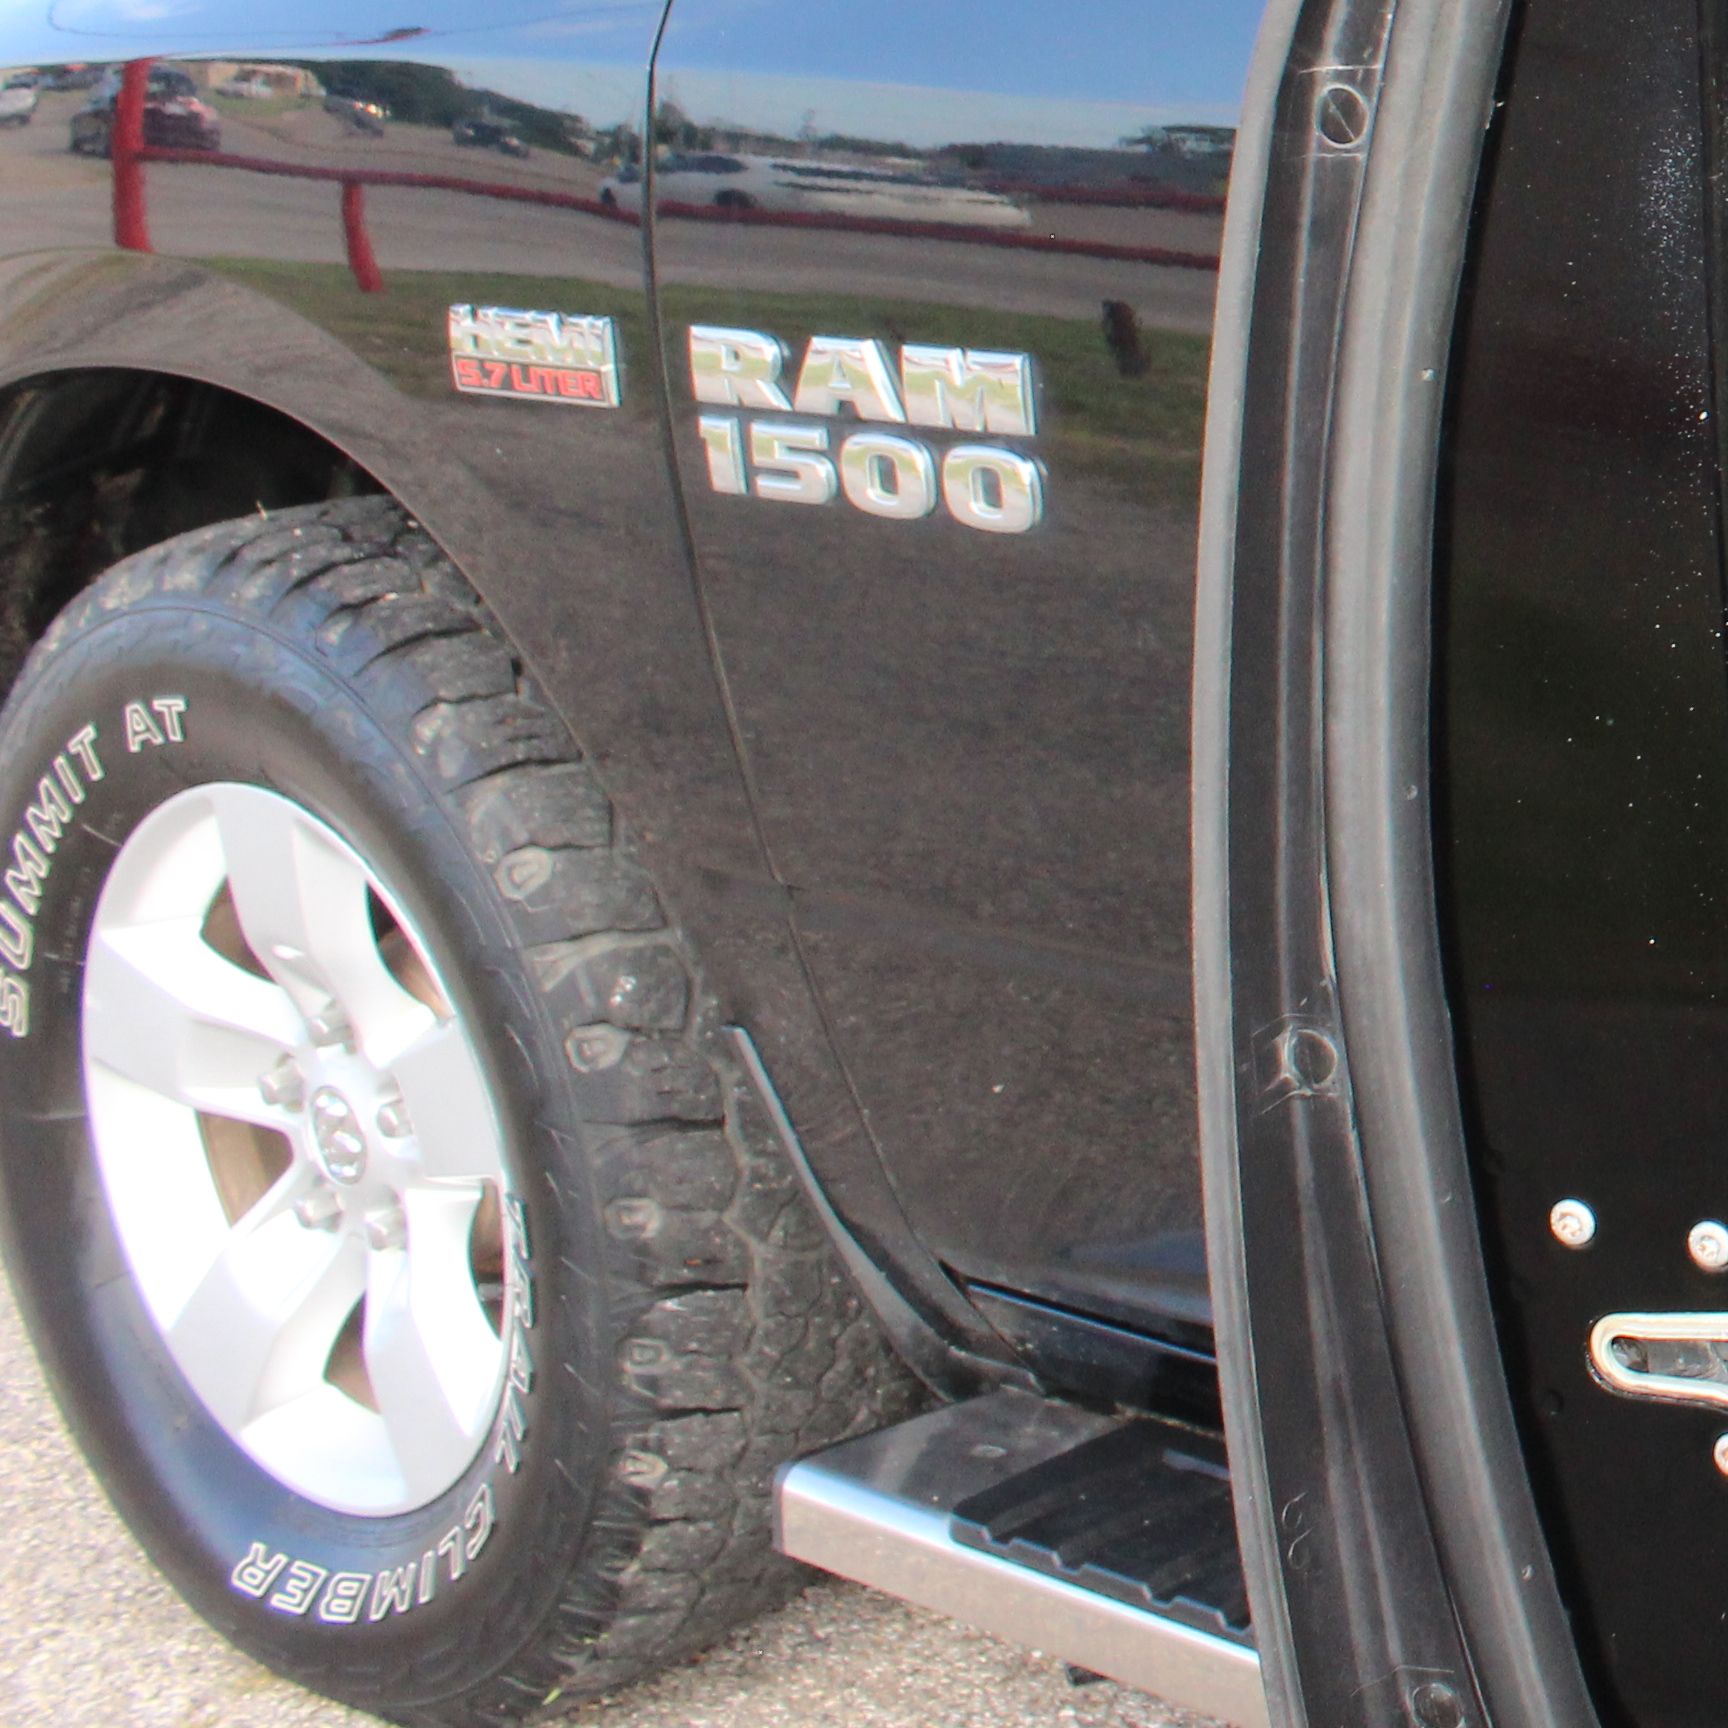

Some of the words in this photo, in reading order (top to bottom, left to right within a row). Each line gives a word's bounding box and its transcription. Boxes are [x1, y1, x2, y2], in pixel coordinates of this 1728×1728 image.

[447, 303, 615, 368] HEMI
[456, 358, 507, 389] 5.7
[511, 363, 603, 400] LITER
[687, 323, 1036, 437] RAM
[698, 413, 1046, 534] 1500
[0, 724, 105, 1039] SUMMIT
[124, 695, 188, 754] AT
[231, 1482, 496, 1624] CLIMBER
